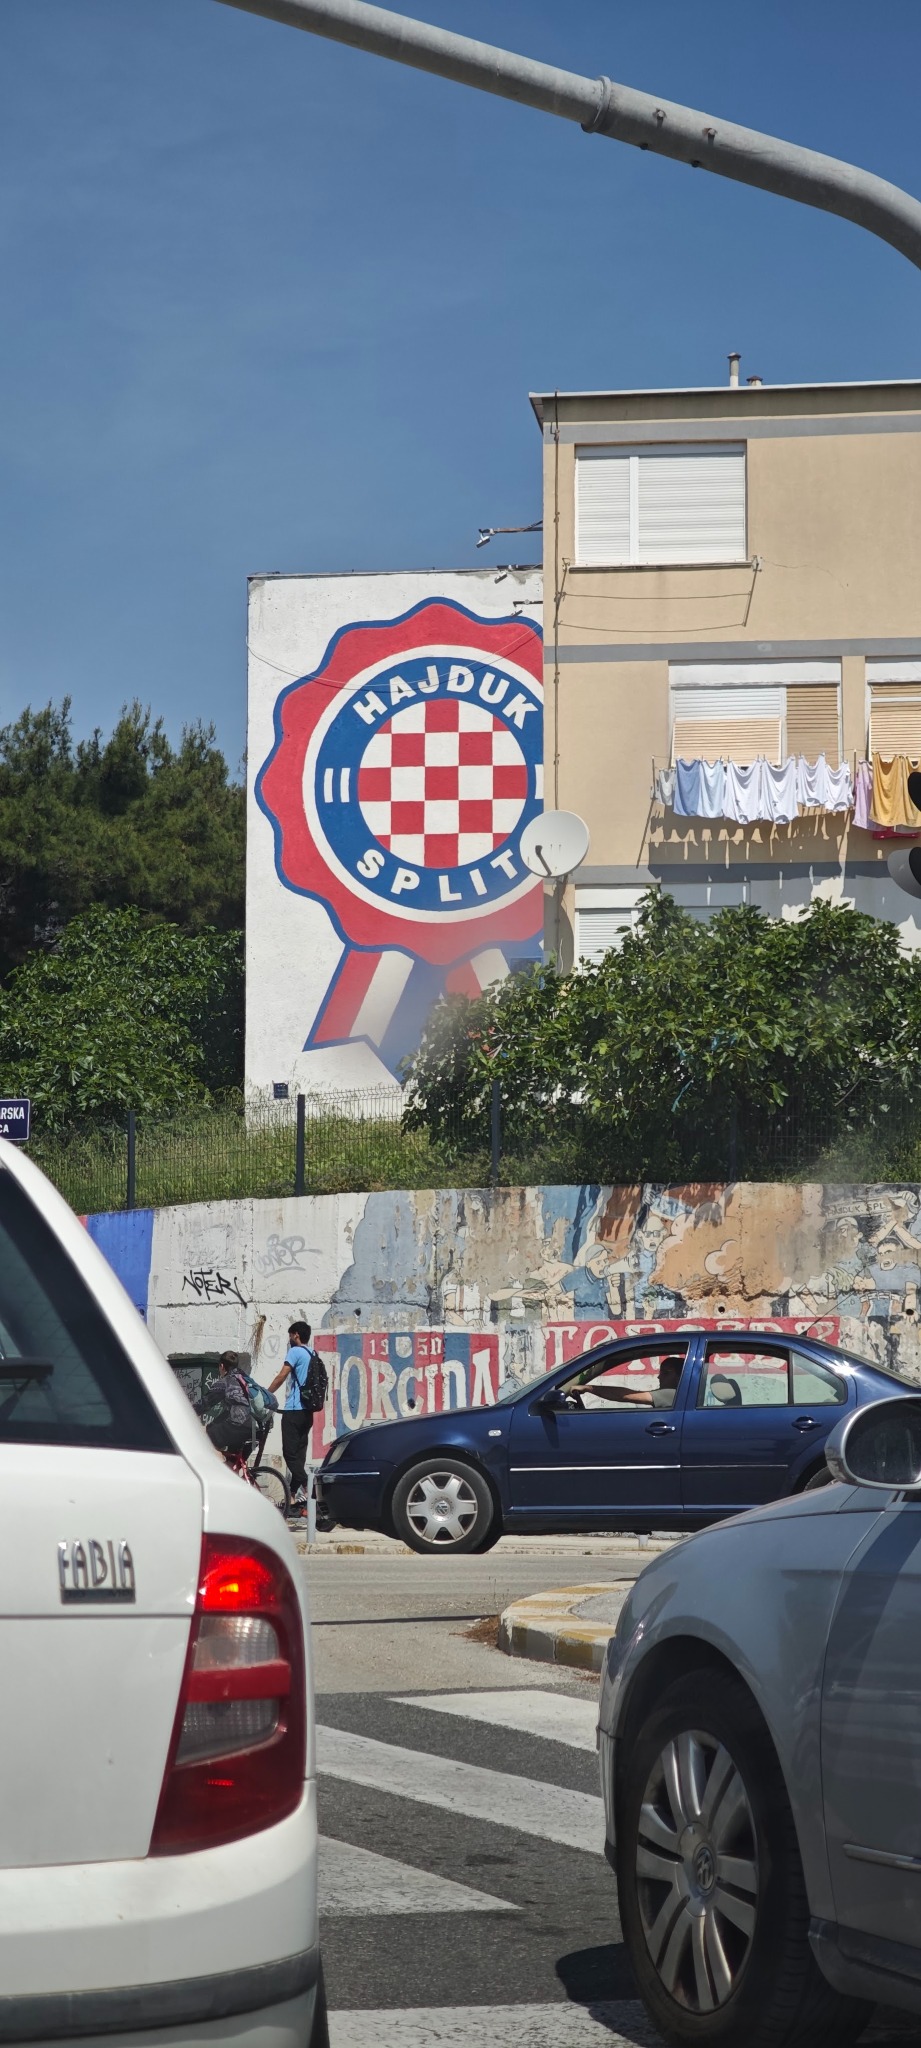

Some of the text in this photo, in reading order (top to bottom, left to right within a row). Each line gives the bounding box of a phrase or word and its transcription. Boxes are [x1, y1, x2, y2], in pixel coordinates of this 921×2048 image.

[352, 664, 539, 729] HAJDUK
[356, 848, 518, 902] SPLIT
[369, 1338, 389, 1356] 19
[317, 1348, 497, 1446] TORCIDA
[57, 1539, 135, 1589] FABIA
